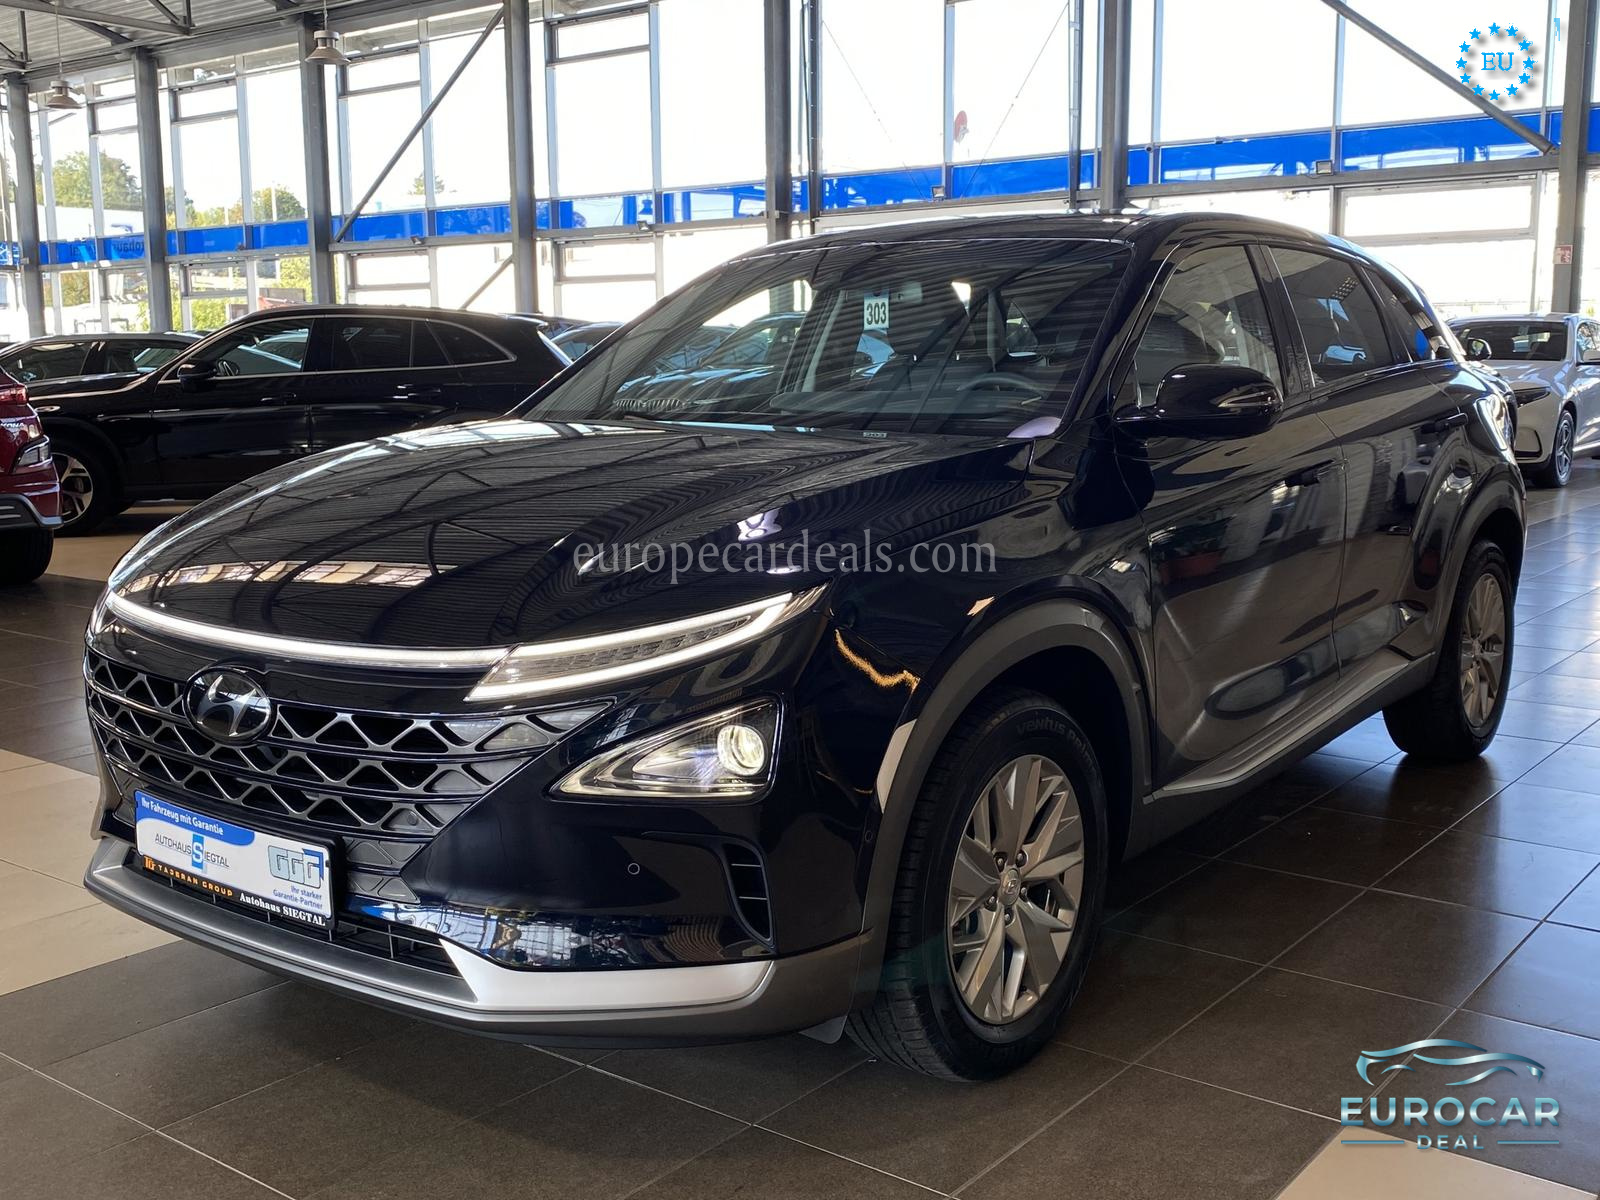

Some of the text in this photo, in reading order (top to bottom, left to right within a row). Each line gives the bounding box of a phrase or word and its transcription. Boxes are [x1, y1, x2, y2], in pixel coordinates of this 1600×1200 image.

[866, 302, 887, 325] 303
[141, 797, 224, 836] Ihr Fahrzeug mit Garantie
[155, 833, 230, 868] AUTOHAUS SIEGTAL
[202, 881, 233, 897] GROUP
[291, 885, 322, 899] Ihr starker
[240, 892, 326, 927] Autohaus SIEGTAL
